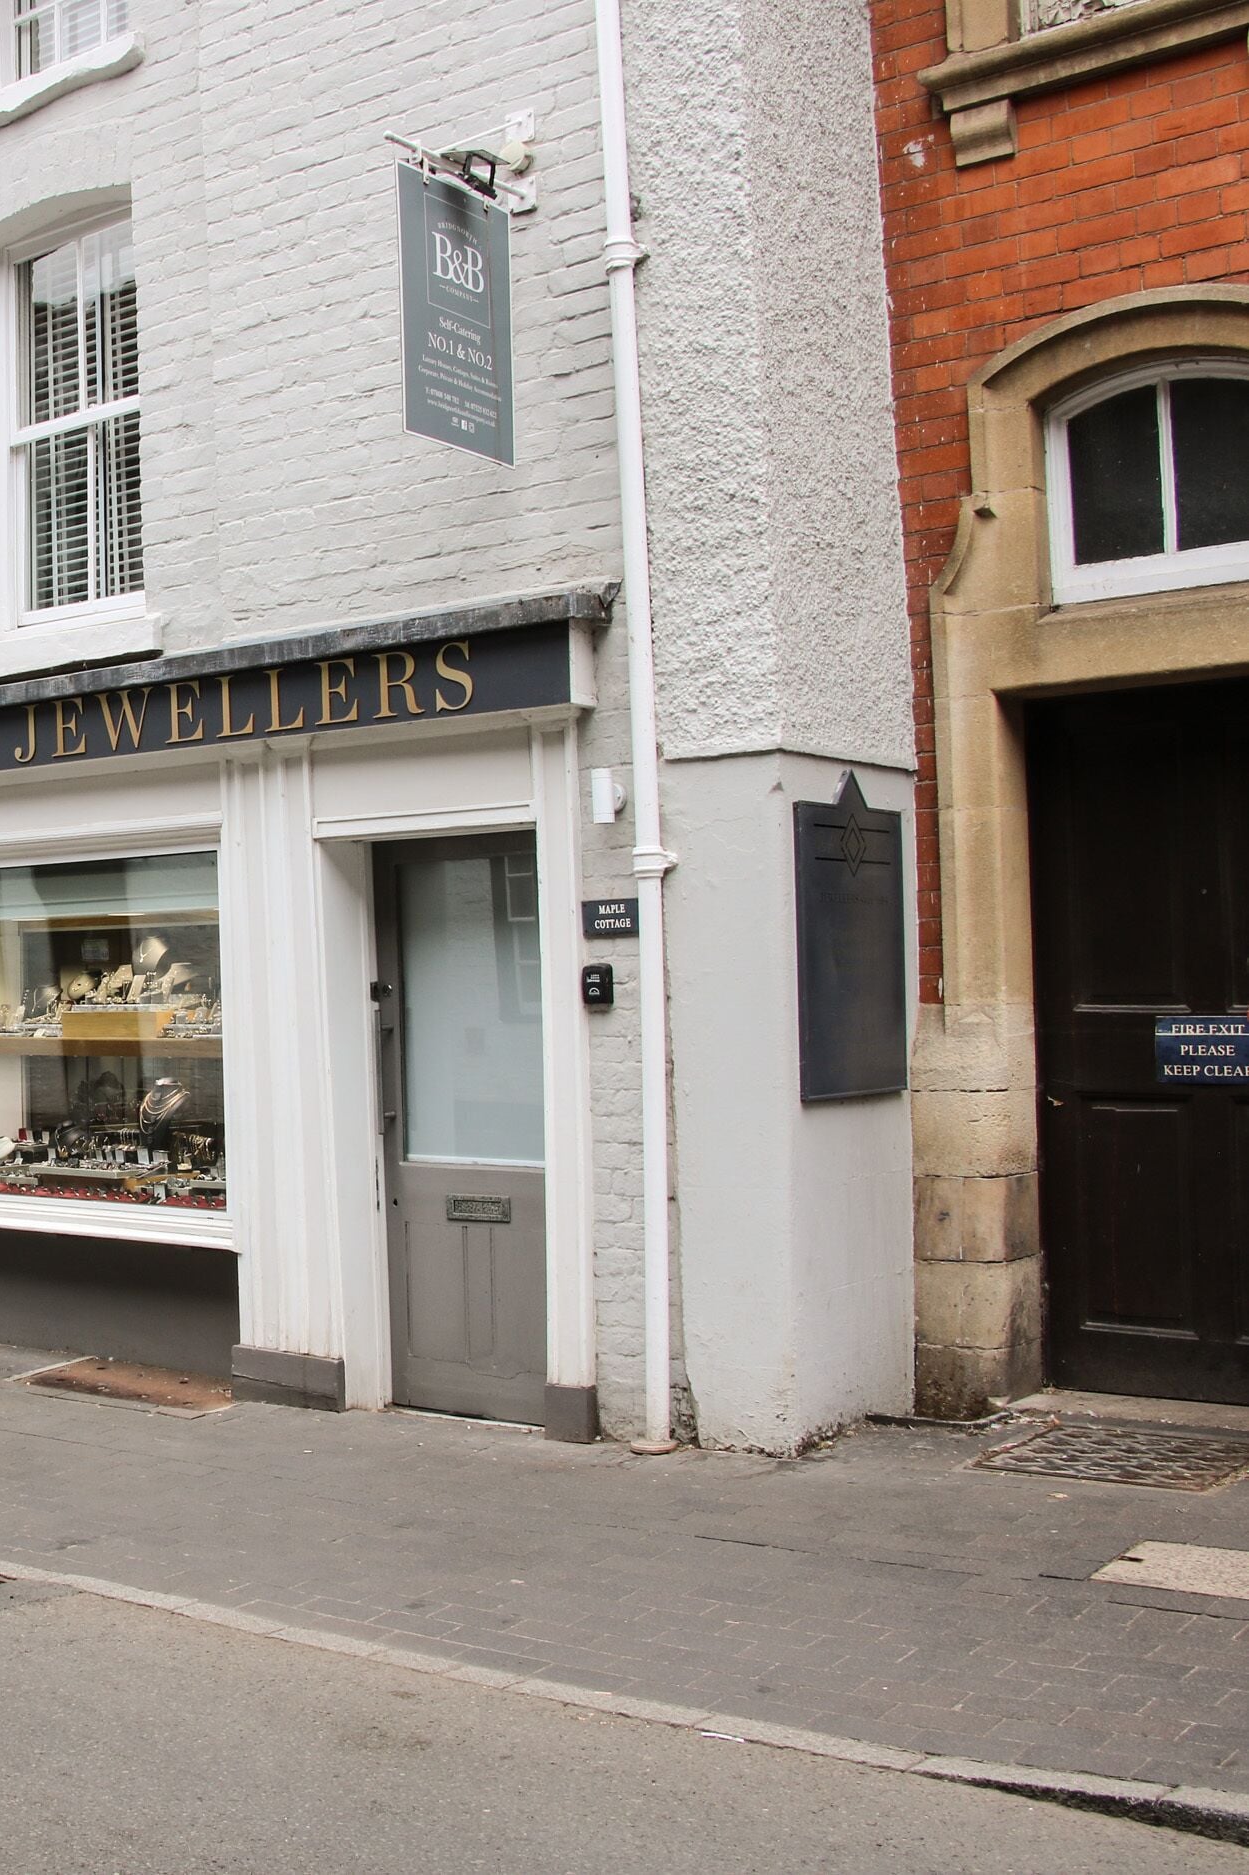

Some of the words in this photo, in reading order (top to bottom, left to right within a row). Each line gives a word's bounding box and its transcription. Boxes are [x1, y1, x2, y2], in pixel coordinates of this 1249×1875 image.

[432, 231, 485, 293] B&B
[439, 316, 481, 345] Self-Catering
[428, 331, 454, 355] NO.1
[456, 343, 466, 360] &
[467, 347, 493, 371] NO.2
[14, 640, 474, 763] JEWELLERS
[598, 904, 626, 914] MAPLE
[594, 918, 631, 929] COTTAGE
[1171, 1024, 1205, 1035] FIRE
[1209, 1024, 1245, 1035] EXIT
[1180, 1045, 1236, 1056] PLEASE
[1163, 1065, 1201, 1076] KEEP
